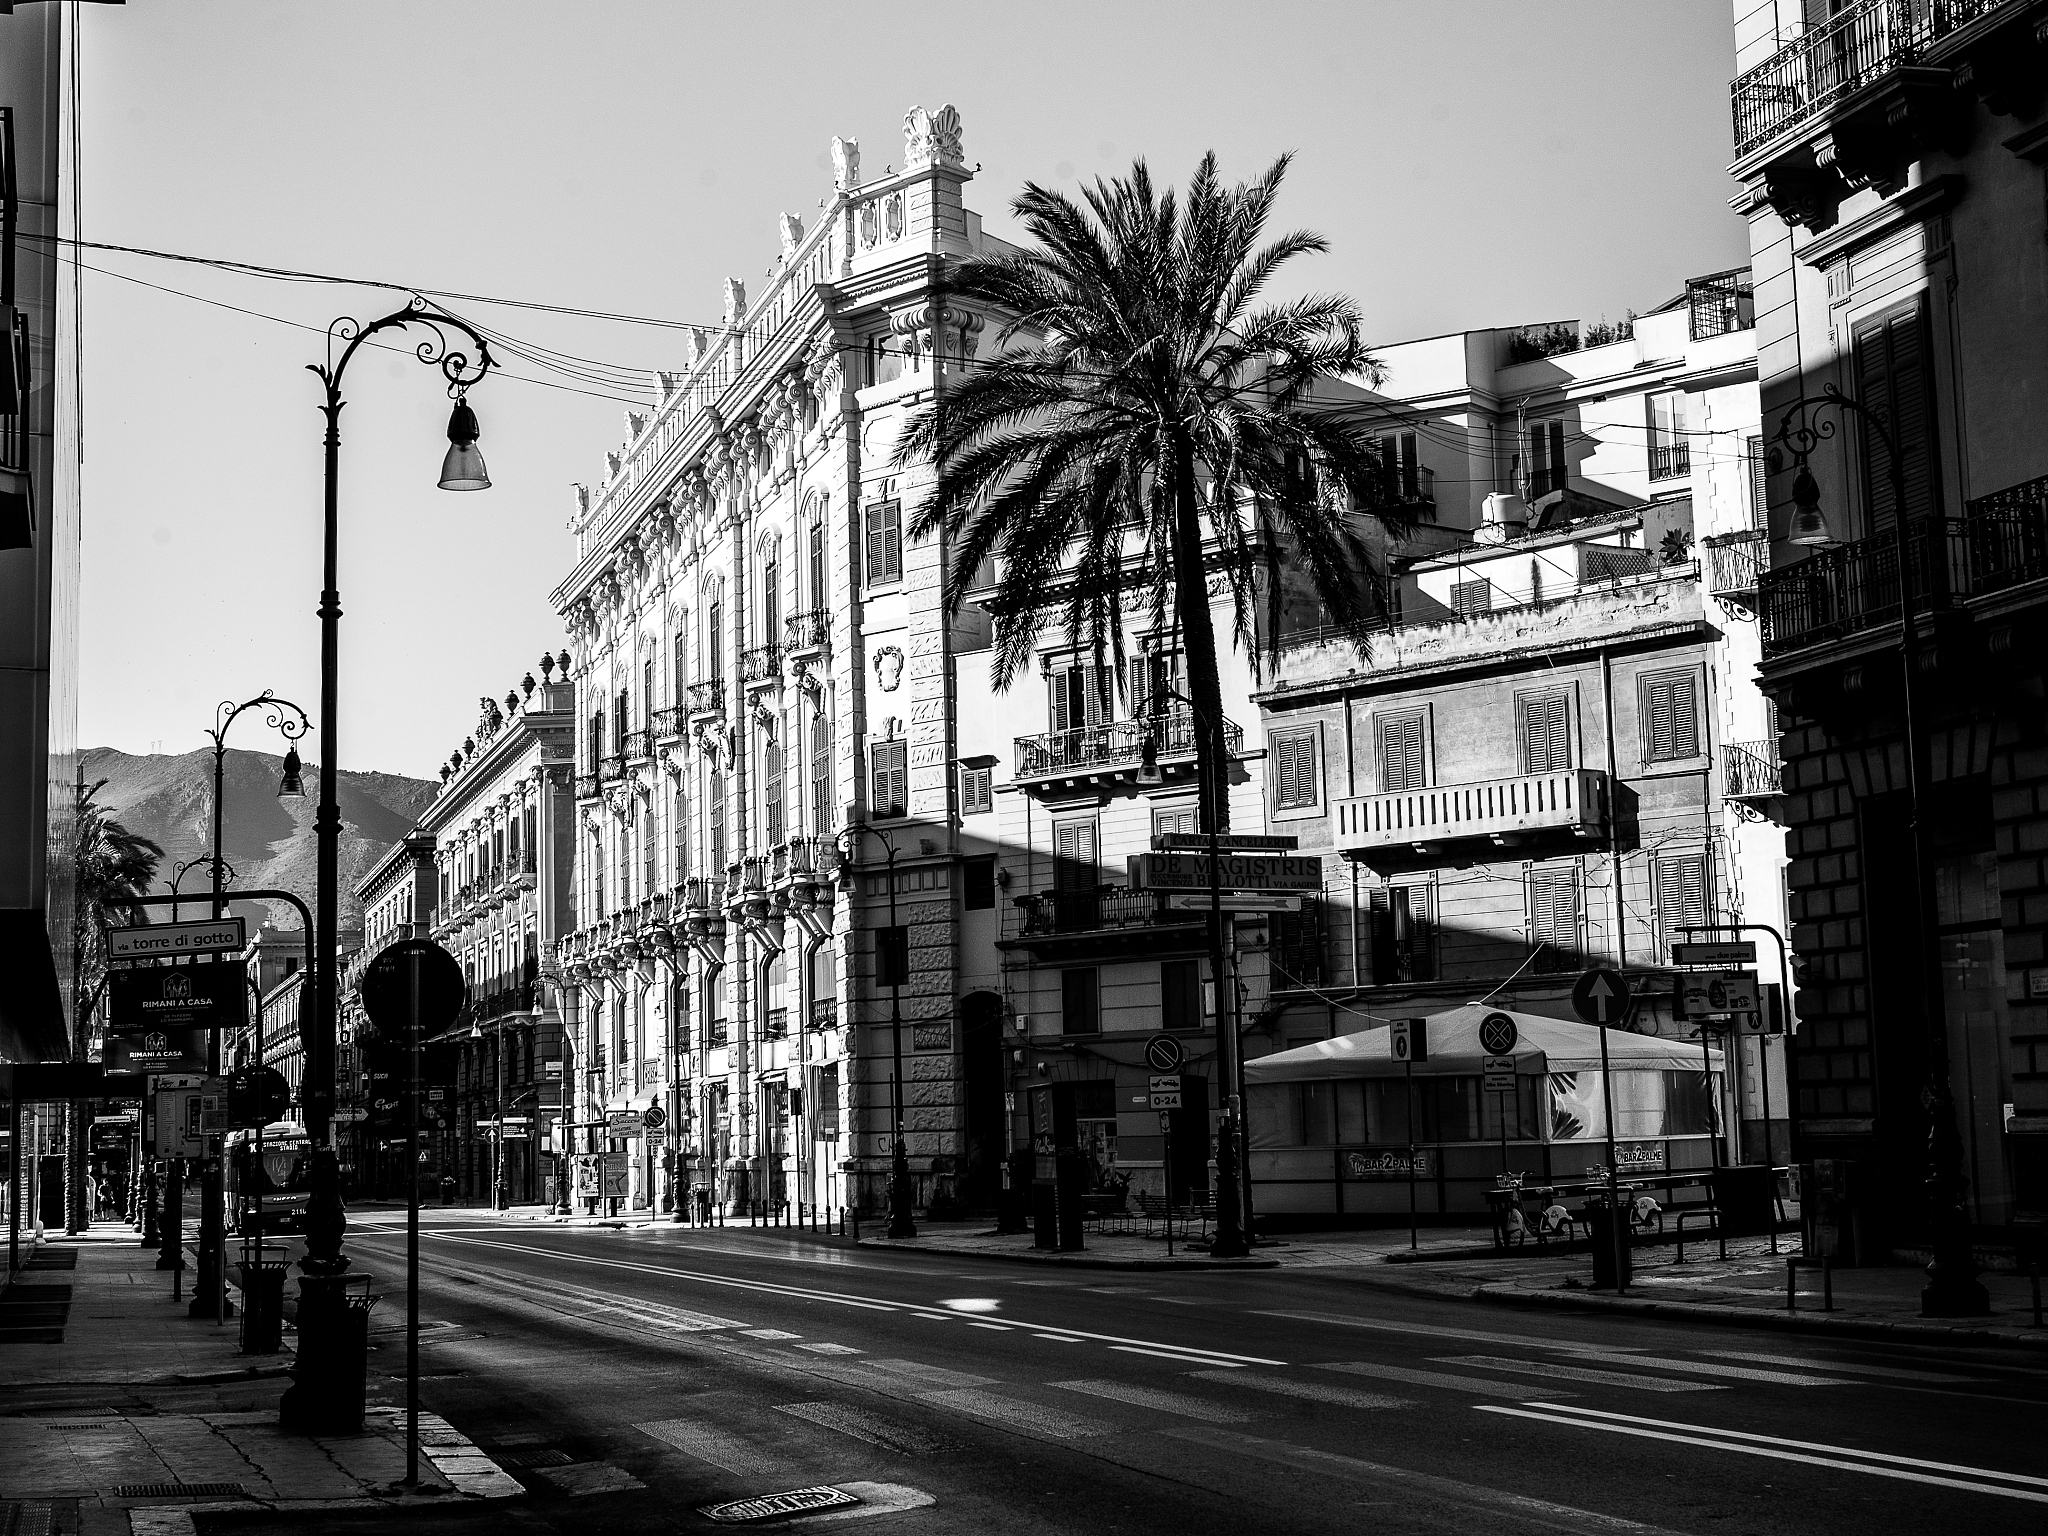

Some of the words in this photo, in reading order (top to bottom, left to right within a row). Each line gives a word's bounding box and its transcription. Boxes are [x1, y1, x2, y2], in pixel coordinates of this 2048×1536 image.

[1173, 836, 1211, 847] CARTA
[1217, 836, 1293, 849] CANCELLERIA
[1151, 856, 1181, 874] DE
[1194, 857, 1319, 876] MAGISTRIS
[1151, 879, 1193, 887] VINCENZO
[1290, 881, 1319, 889] GAGINI
[133, 938, 170, 950] torre
[175, 934, 188, 946] di
[193, 932, 234, 947] gotto
[1717, 951, 1730, 959] due
[1730, 951, 1750, 960] palme
[142, 999, 176, 1009] RIMANI
[187, 998, 213, 1006] CASA
[129, 1051, 155, 1059] RIMANI
[1153, 1096, 1178, 1105] 0-24
